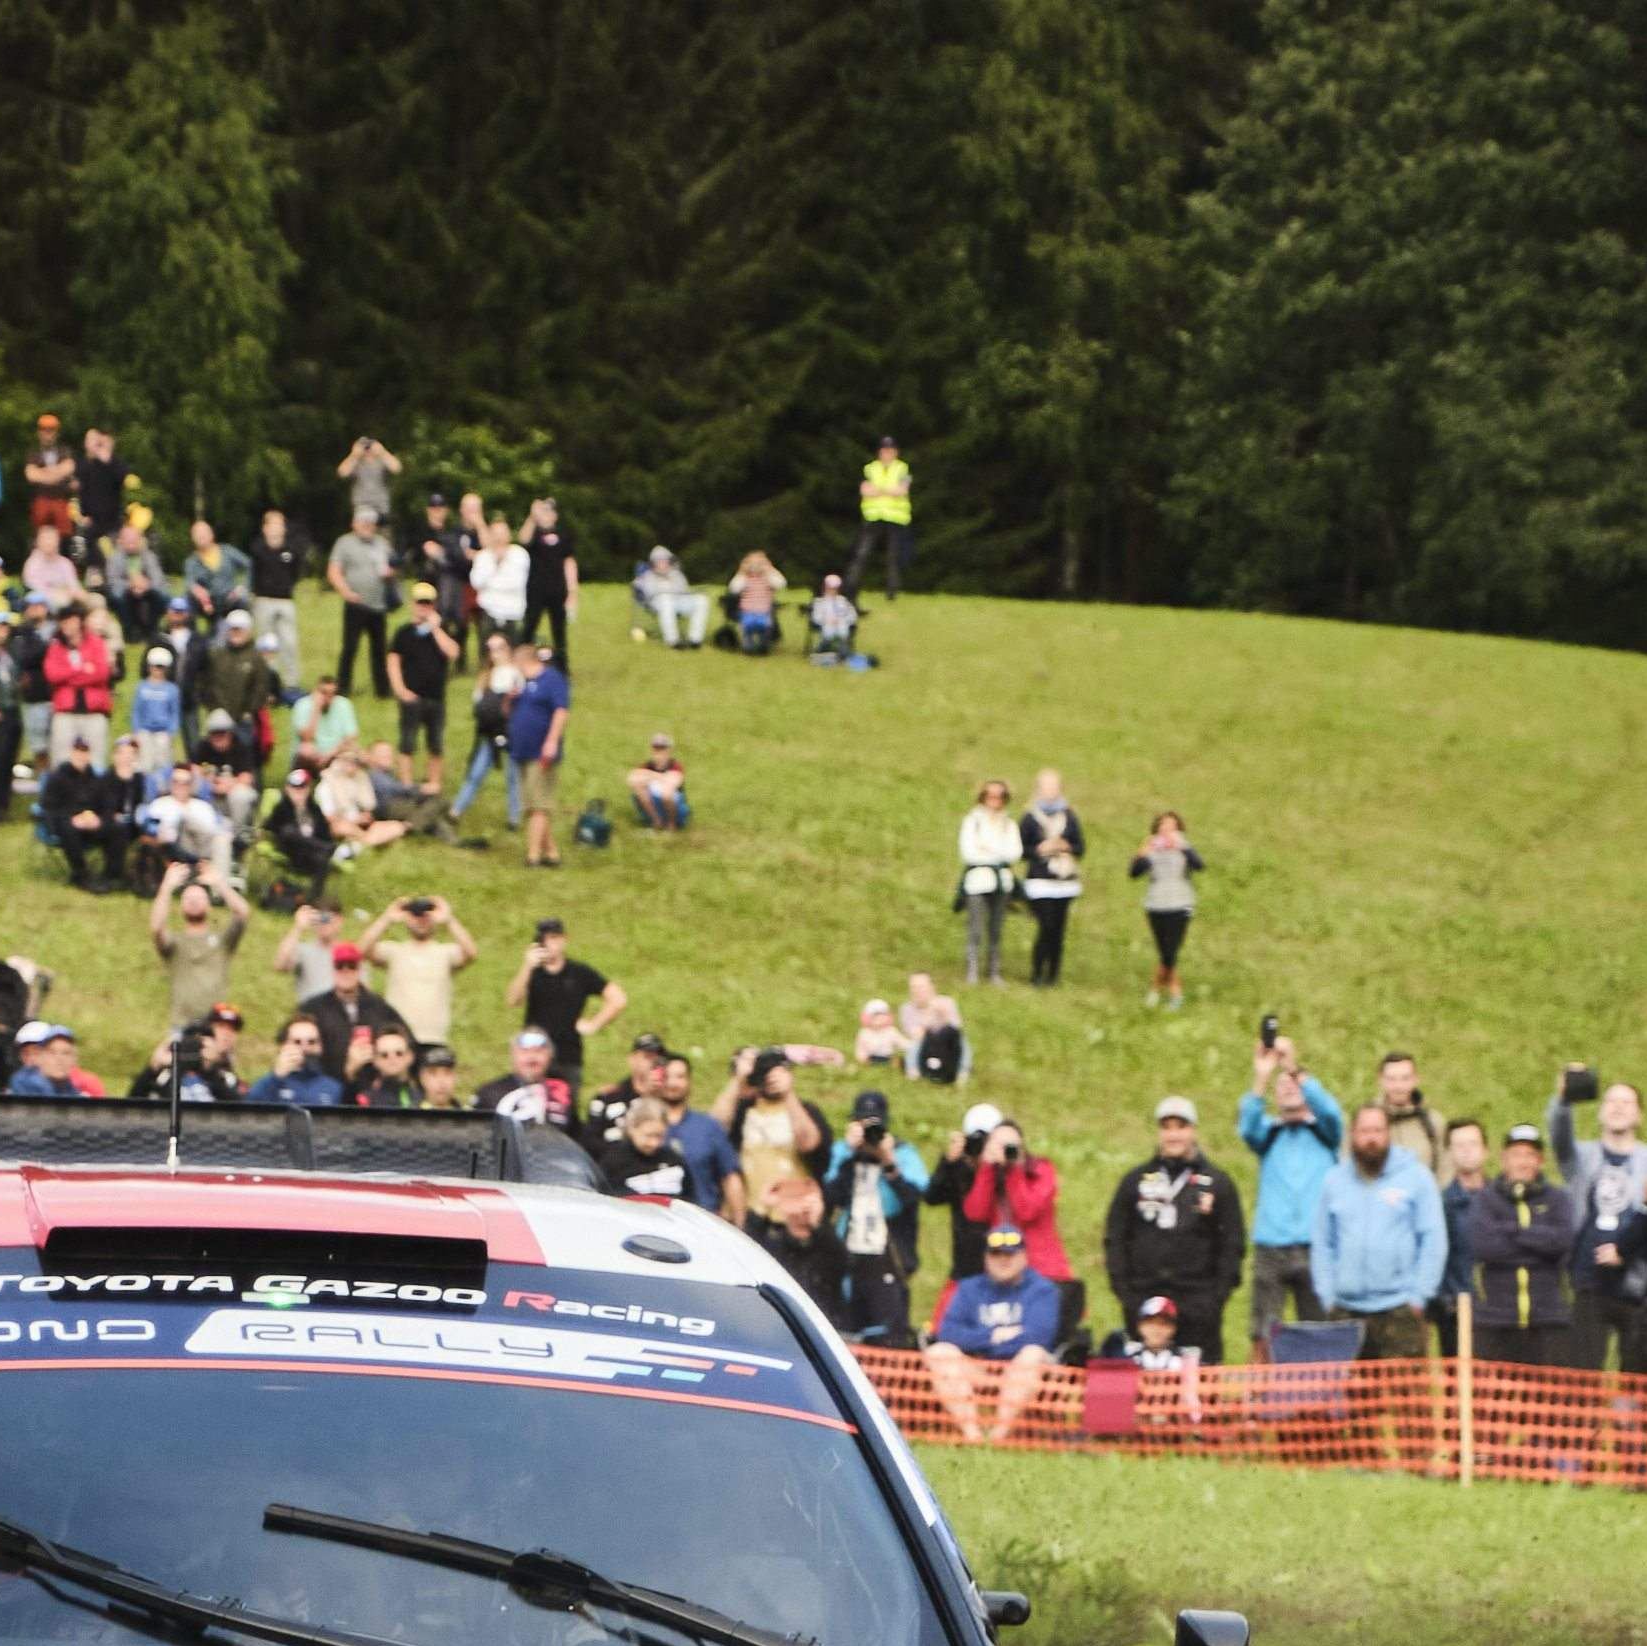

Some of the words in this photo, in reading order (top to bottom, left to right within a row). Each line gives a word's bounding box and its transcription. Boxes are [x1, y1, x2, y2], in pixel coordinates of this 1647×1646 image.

[253, 1275, 487, 1305] GAZOO
[504, 1290, 716, 1336] Racing
[240, 1323, 554, 1358] RALLY
